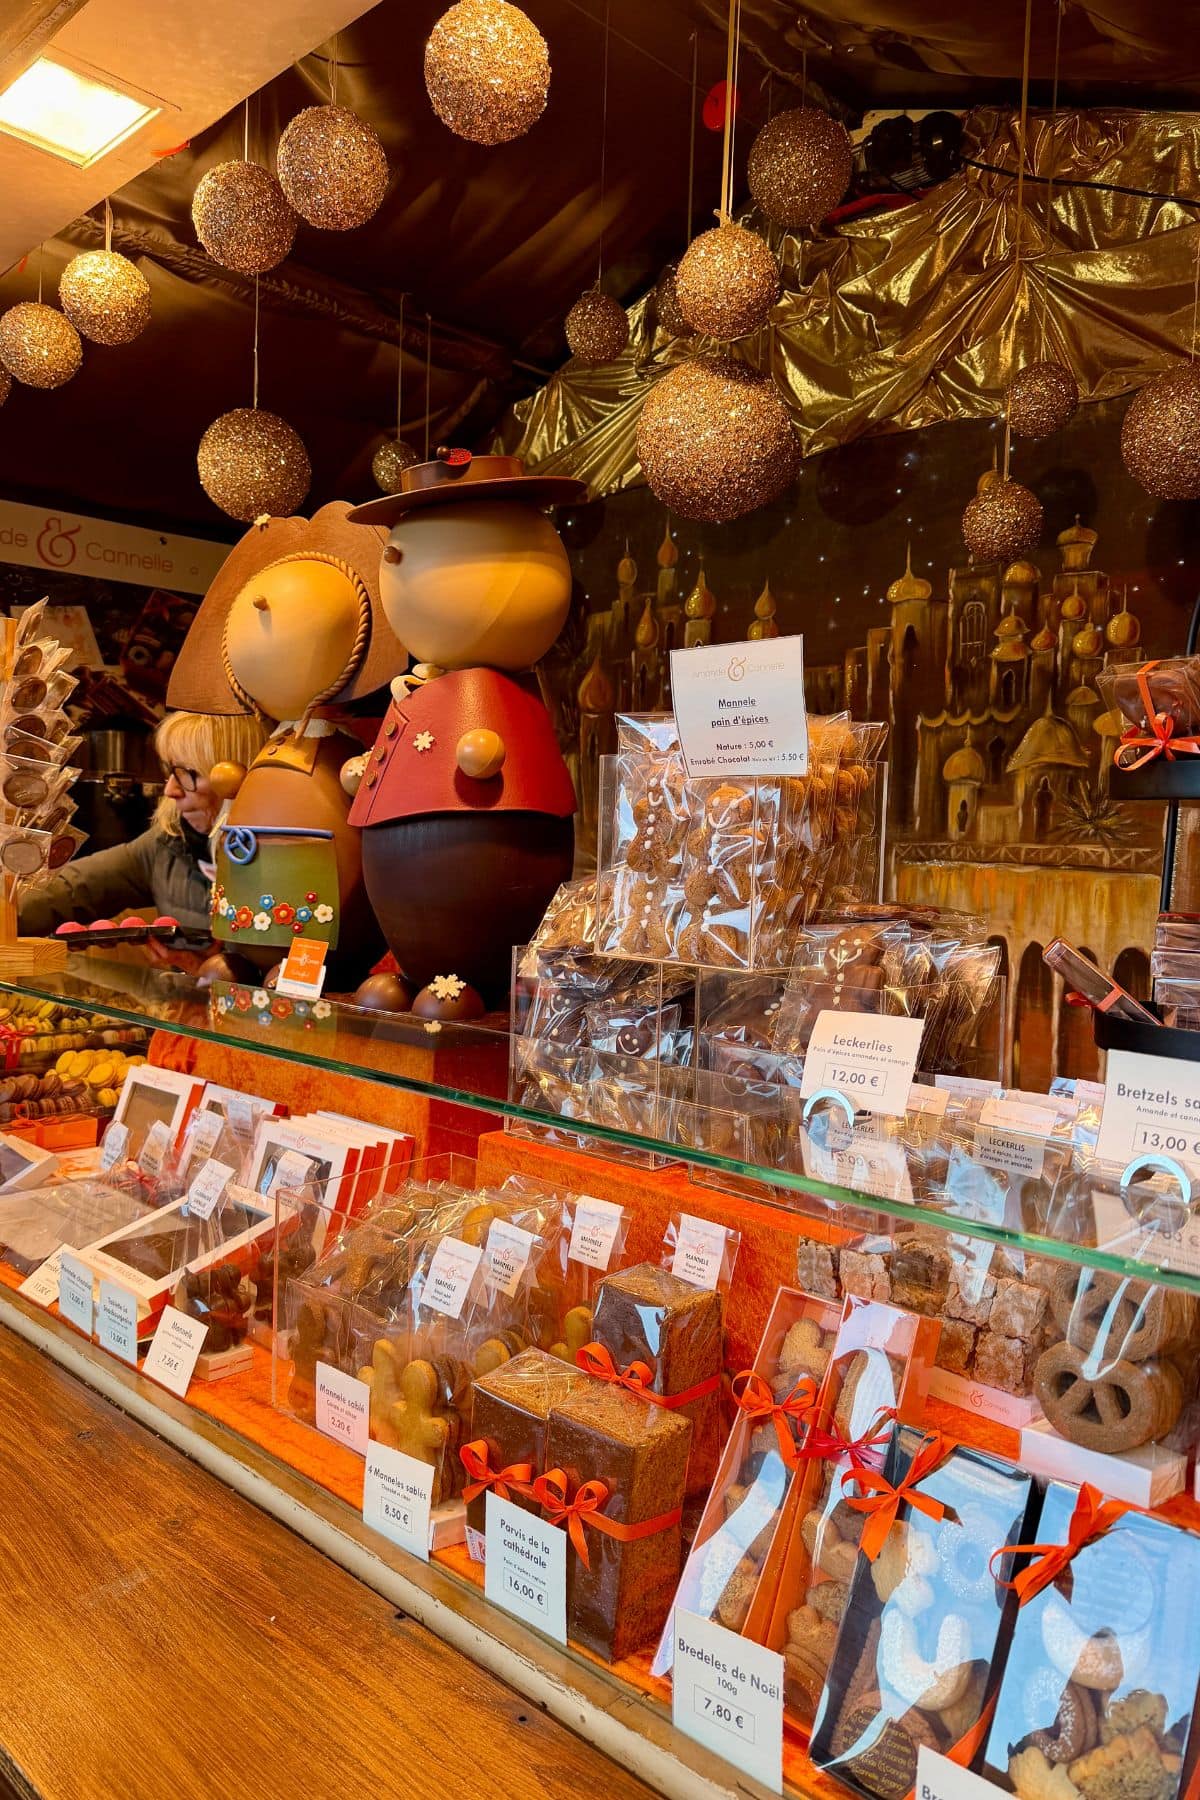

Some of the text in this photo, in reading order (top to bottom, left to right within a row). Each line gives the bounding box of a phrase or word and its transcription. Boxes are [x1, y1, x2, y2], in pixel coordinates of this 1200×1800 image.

[36, 517, 81, 568] &
[85, 542, 173, 573] Cannelle
[718, 697, 756, 709] Mannele
[711, 714, 769, 729] pain d'épices
[716, 742, 742, 751] Nature
[749, 740, 767, 750] 5,00
[768, 740, 774, 748] €
[717, 755, 750, 764] Chocolat
[833, 1034, 894, 1053] Leckerlies
[851, 1053, 879, 1062] amandes
[832, 1069, 879, 1087] 12,00 €
[1116, 1083, 1178, 1106] Bretzels
[1136, 1105, 1169, 1117] Amande
[989, 1136, 1025, 1152] LECKERLIS
[1142, 1131, 1187, 1152] 13,00
[320, 1383, 347, 1404] Mannele
[368, 1464, 427, 1500] 4 Manneles sablés
[402, 1513, 409, 1525] €
[500, 1518, 550, 1555] Parvis de la
[503, 1538, 547, 1569] cathédrale
[509, 1575, 544, 1606] 16,00 €
[678, 1637, 780, 1700] Bredeles de Noël
[717, 1676, 738, 1696] 100g
[704, 1697, 744, 1729] 7,80 €
